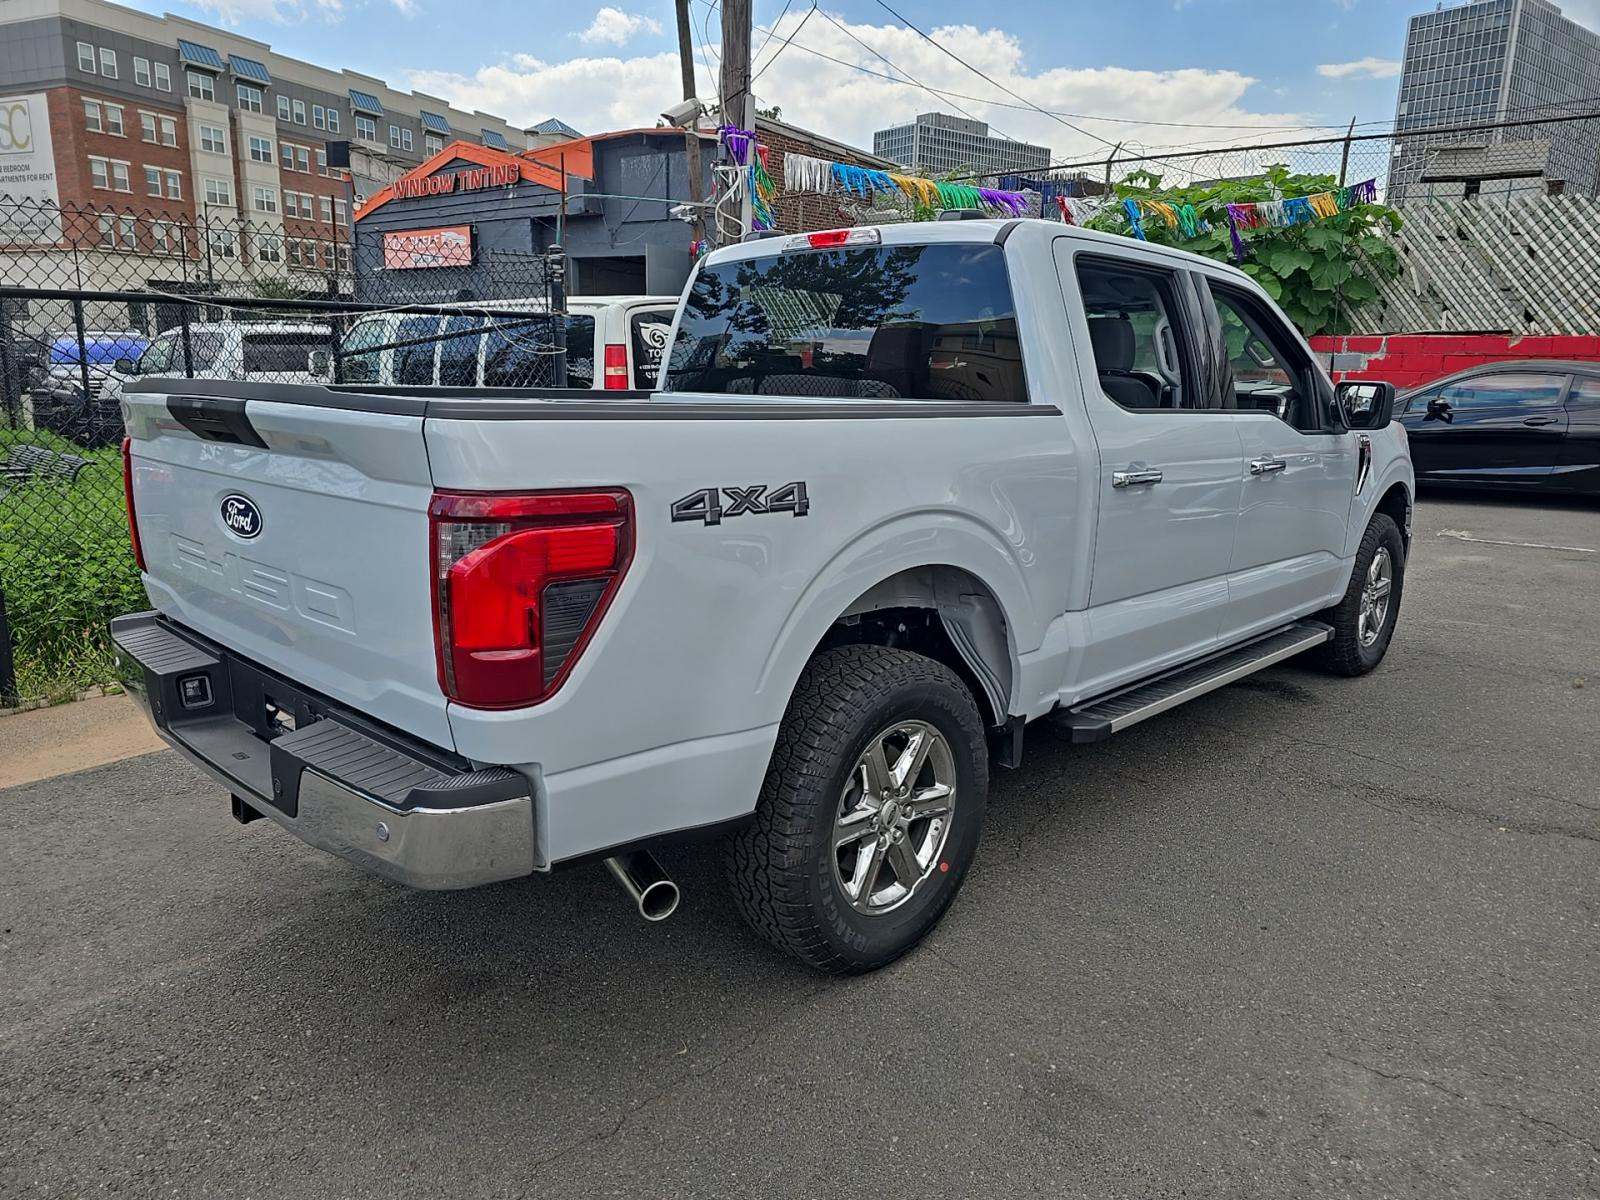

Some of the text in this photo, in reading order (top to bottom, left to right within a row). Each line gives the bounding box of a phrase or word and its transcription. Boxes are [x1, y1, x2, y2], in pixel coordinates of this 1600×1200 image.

[27, 174, 38, 182] FOR
[39, 173, 53, 181] RENT
[393, 163, 519, 199] WINDOW TINTING
[226, 500, 253, 531] Ford
